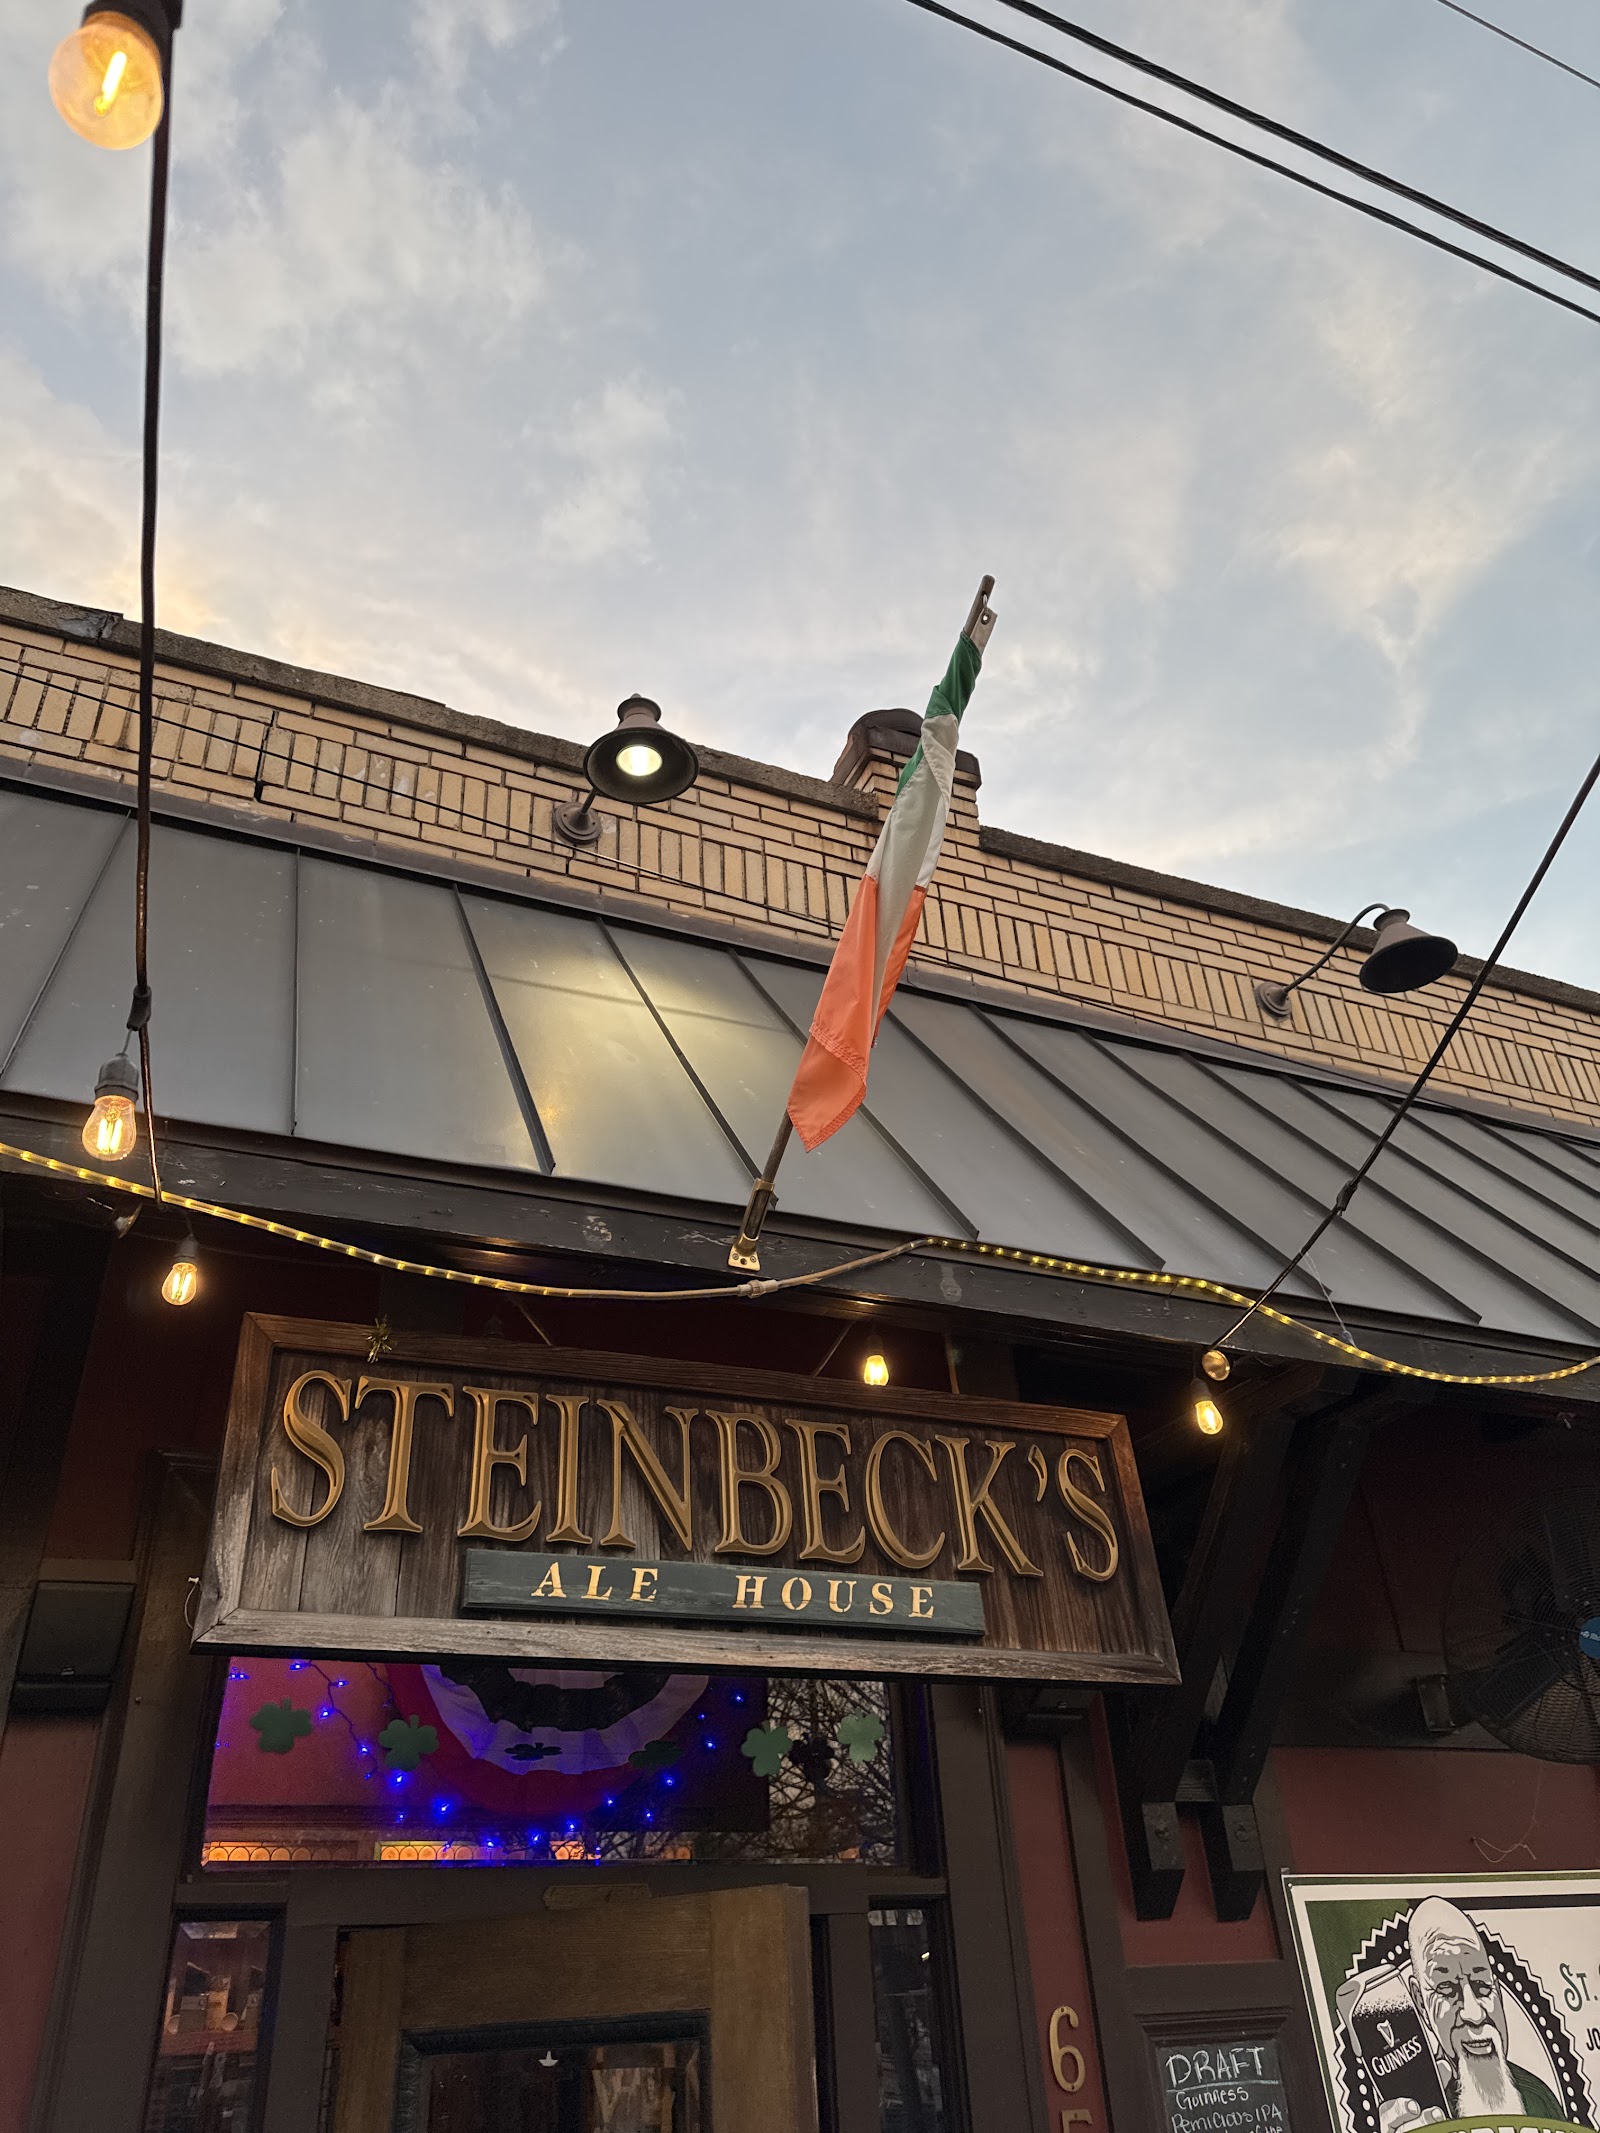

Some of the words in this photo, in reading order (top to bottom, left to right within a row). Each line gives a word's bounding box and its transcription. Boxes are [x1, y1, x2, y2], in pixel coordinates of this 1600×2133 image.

[270, 1369, 1119, 1582] STEINBECK'S
[531, 1561, 659, 1602] ALE
[732, 1575, 934, 1619] HOUSE
[1165, 2046, 1265, 2088] DRAFT
[1371, 2034, 1422, 2077] GUINNESS
[1175, 2086, 1249, 2110] Guinness
[1255, 2102, 1283, 2122] IPA
